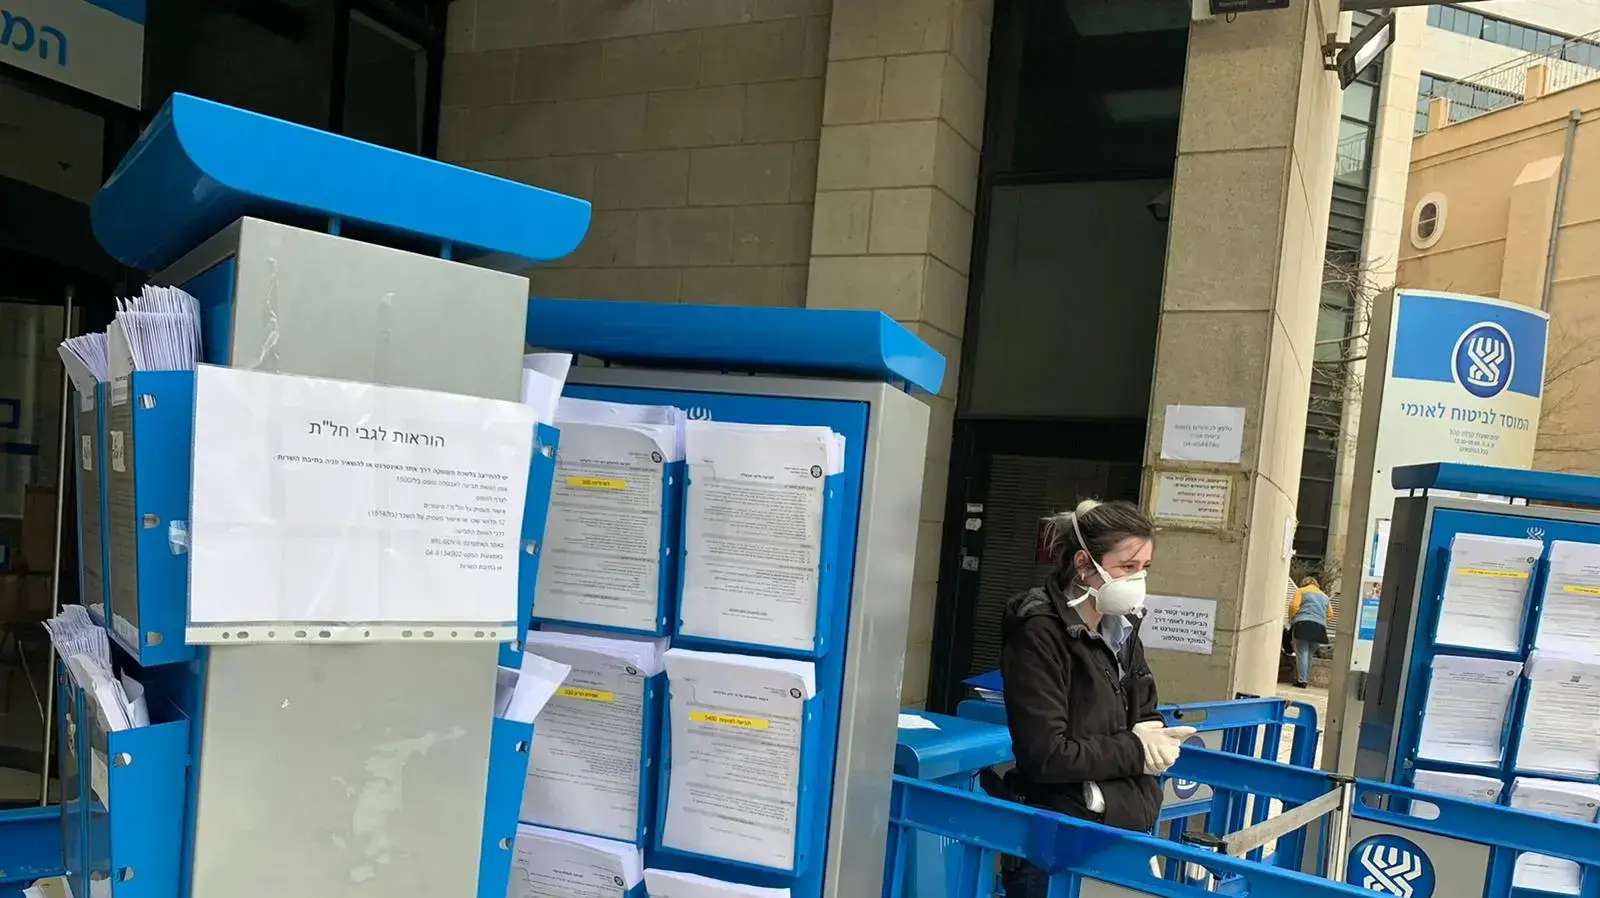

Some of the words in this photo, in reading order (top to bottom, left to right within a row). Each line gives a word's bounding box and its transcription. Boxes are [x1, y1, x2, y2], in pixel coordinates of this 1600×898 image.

[1401, 402, 1446, 419] לאומי
[1451, 407, 1497, 425] לביטוח
[1499, 413, 1529, 431] המוסד
[308, 420, 349, 438] חל"ת
[355, 426, 388, 442] לגבי
[392, 430, 446, 448] הוראות
[302, 456, 324, 464] בתיבת
[340, 459, 365, 467] להשאיר
[456, 470, 476, 478] בלשכת
[477, 471, 500, 479] להתייצב
[1164, 608, 1178, 616] קשר
[1179, 609, 1195, 617] ליצור
[1167, 617, 1184, 625] לאומי
